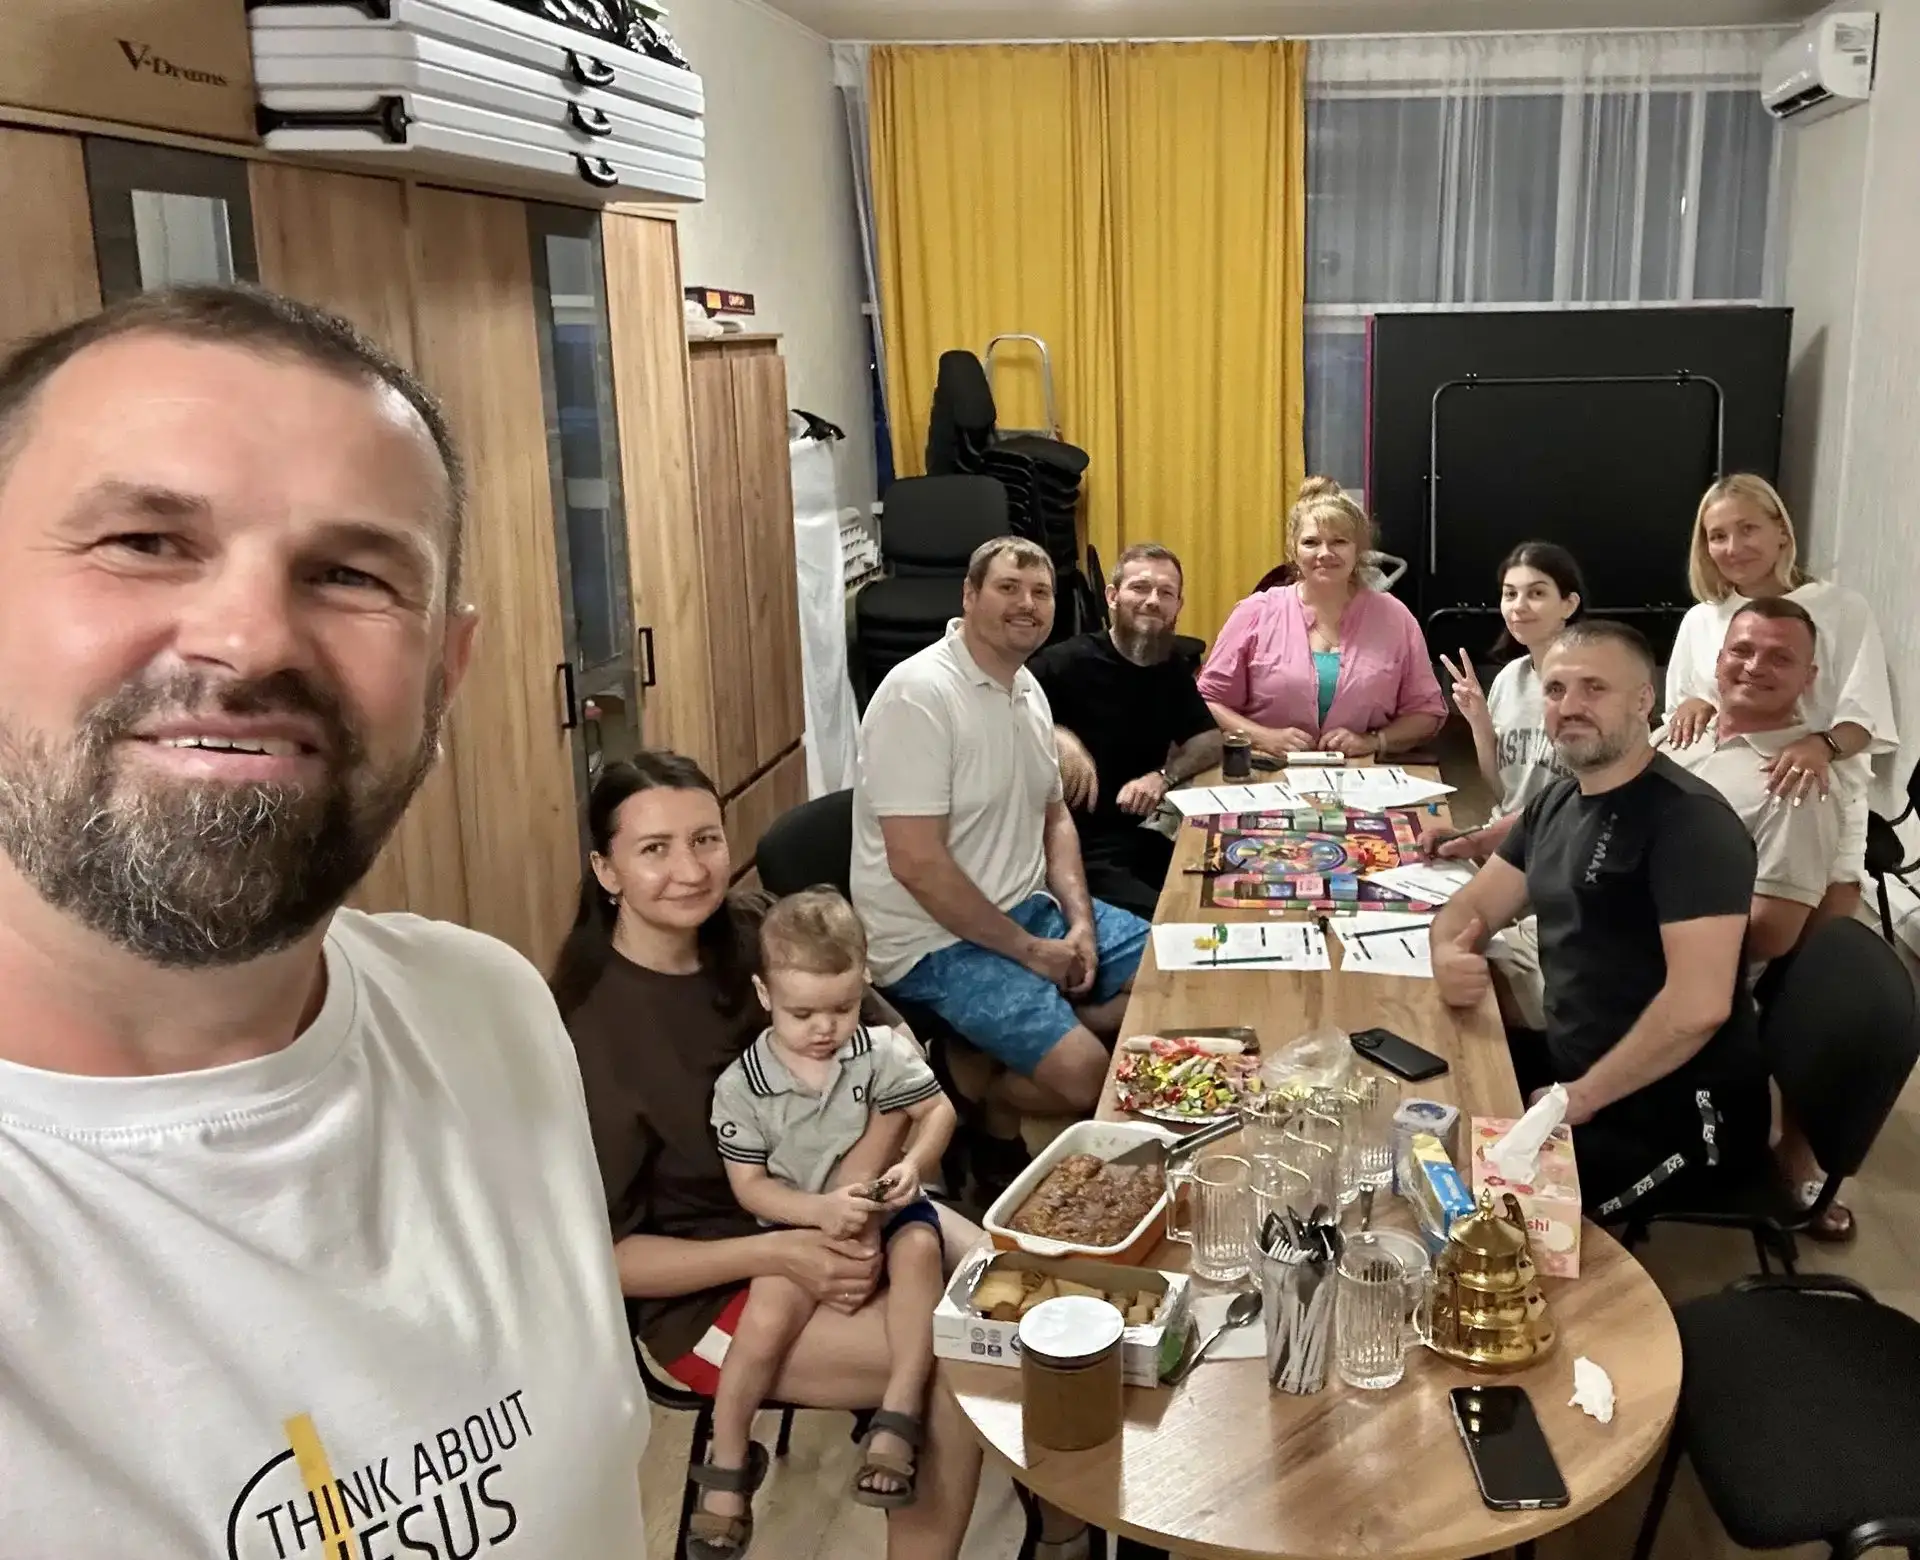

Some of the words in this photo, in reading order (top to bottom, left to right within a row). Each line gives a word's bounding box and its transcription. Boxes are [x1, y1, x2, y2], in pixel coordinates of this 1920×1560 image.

[114, 38, 228, 86] V-Drums
[720, 1121, 737, 1138] G
[256, 1457, 402, 1560] THINK
[412, 1389, 532, 1496] ABOUT
[337, 1464, 517, 1560] ESUS
